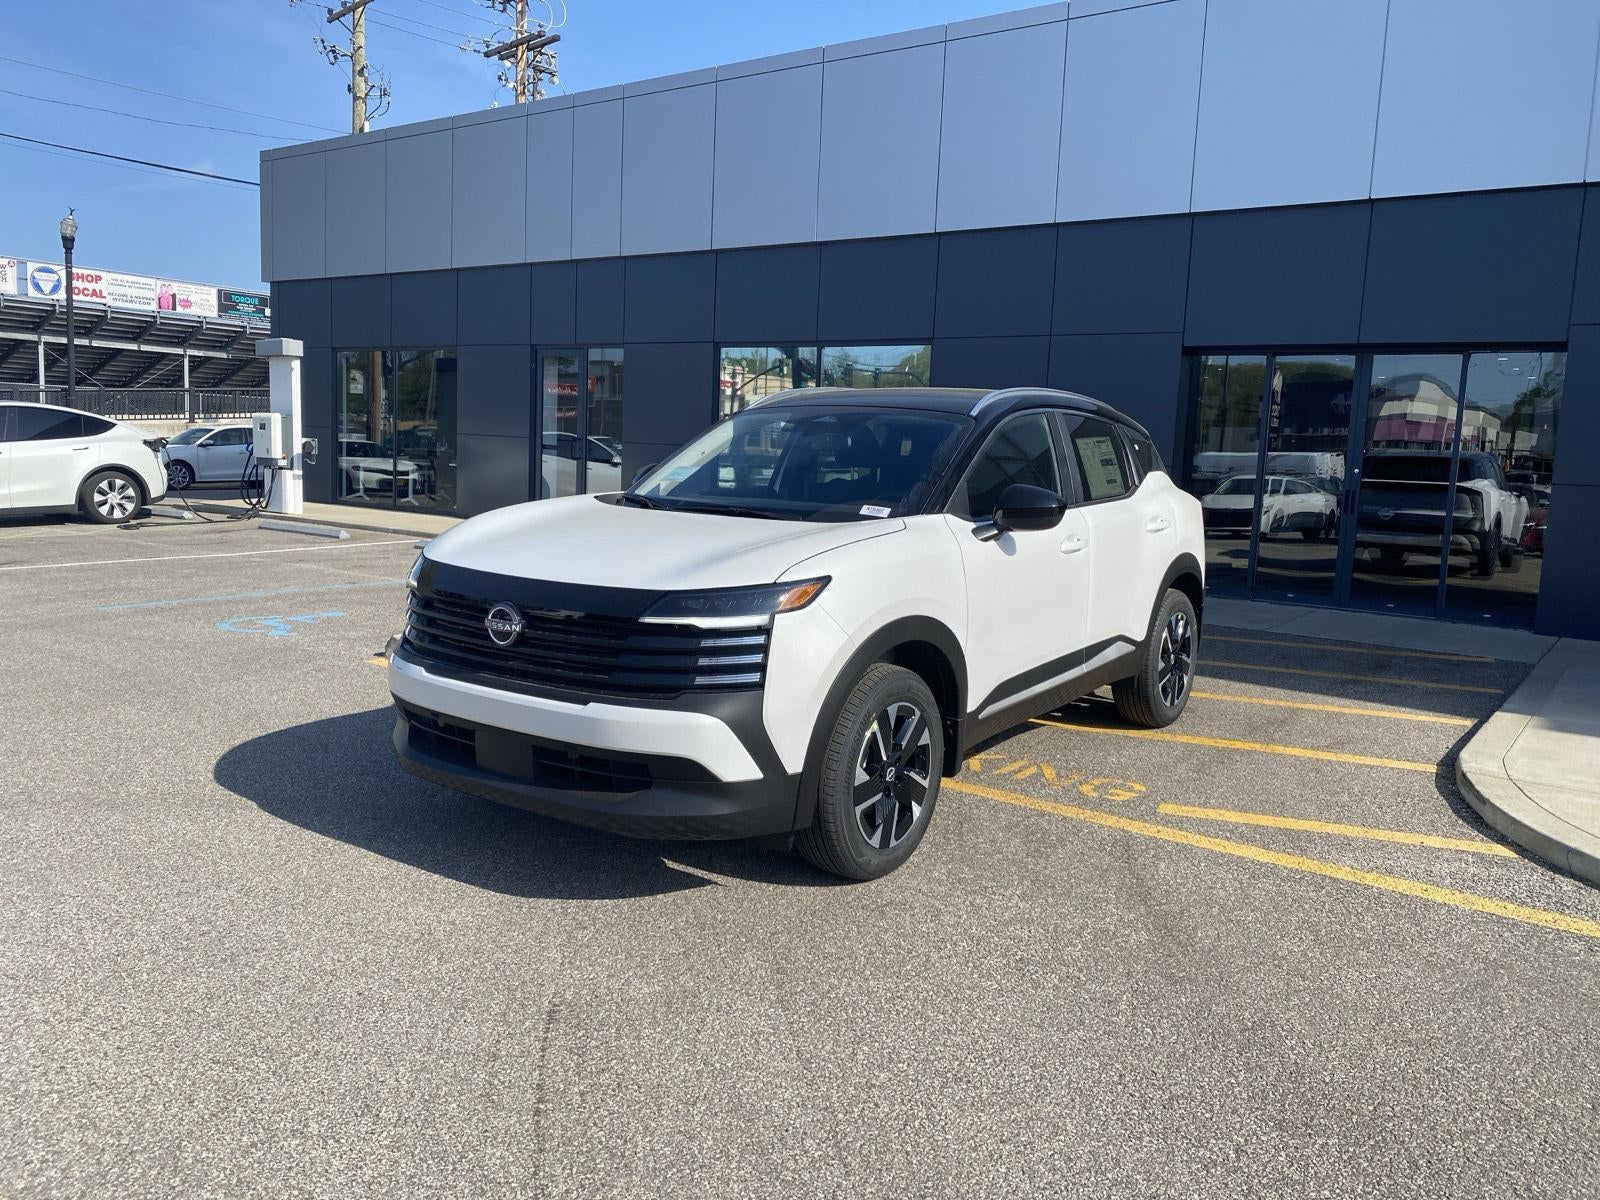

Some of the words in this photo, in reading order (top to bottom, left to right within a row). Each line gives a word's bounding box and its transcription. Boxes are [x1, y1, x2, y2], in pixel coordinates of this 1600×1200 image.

[65, 286, 106, 299] OCAL
[231, 294, 260, 305] TORQUE
[484, 618, 520, 632] NISSAN
